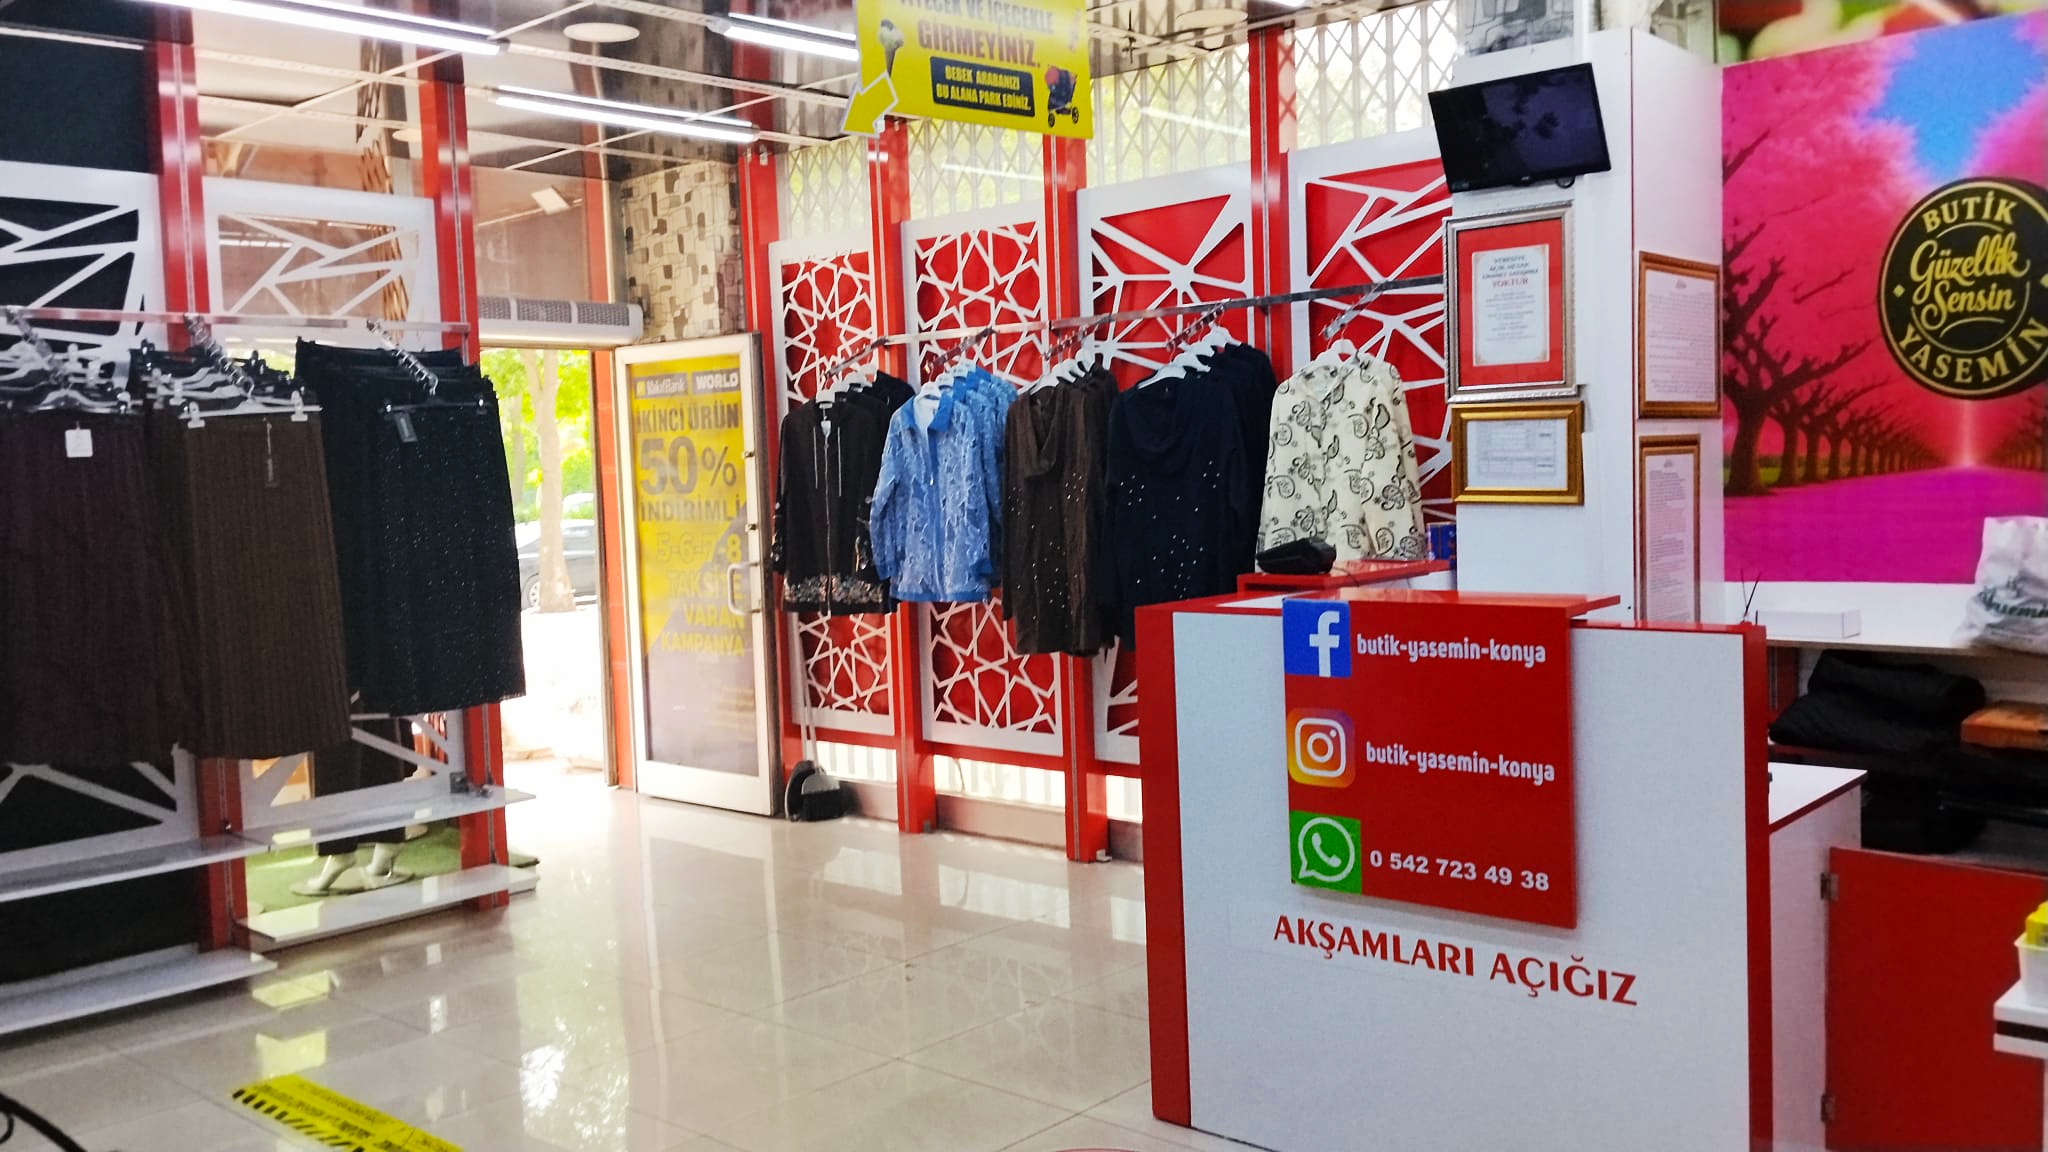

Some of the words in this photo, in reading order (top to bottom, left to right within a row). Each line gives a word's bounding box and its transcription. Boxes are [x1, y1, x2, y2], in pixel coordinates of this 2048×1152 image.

[979, 90, 1002, 106] PARK
[1922, 190, 2019, 233] BUTİK
[1910, 231, 2031, 305] Güzellik
[1920, 282, 2016, 331] Sensin
[1899, 316, 2048, 384] YASEMİN
[696, 372, 739, 390] WORLD
[637, 405, 685, 433] İKİNCİ
[688, 400, 739, 431] ÜRÜN
[684, 602, 745, 630] VARAN
[661, 630, 745, 657] KAMPANYA
[1356, 633, 1546, 668] butik-yasemin-konya
[1366, 741, 1556, 786] butik-yasemin-konya
[1369, 849, 1383, 868] 0
[1389, 852, 1429, 875] 542
[1436, 858, 1477, 881] 723
[1484, 865, 1513, 886] 49
[1520, 869, 1550, 892] 38
[1273, 914, 1475, 977] AKŞAMLARI
[1490, 952, 1638, 1007] AÇIĞIZ
